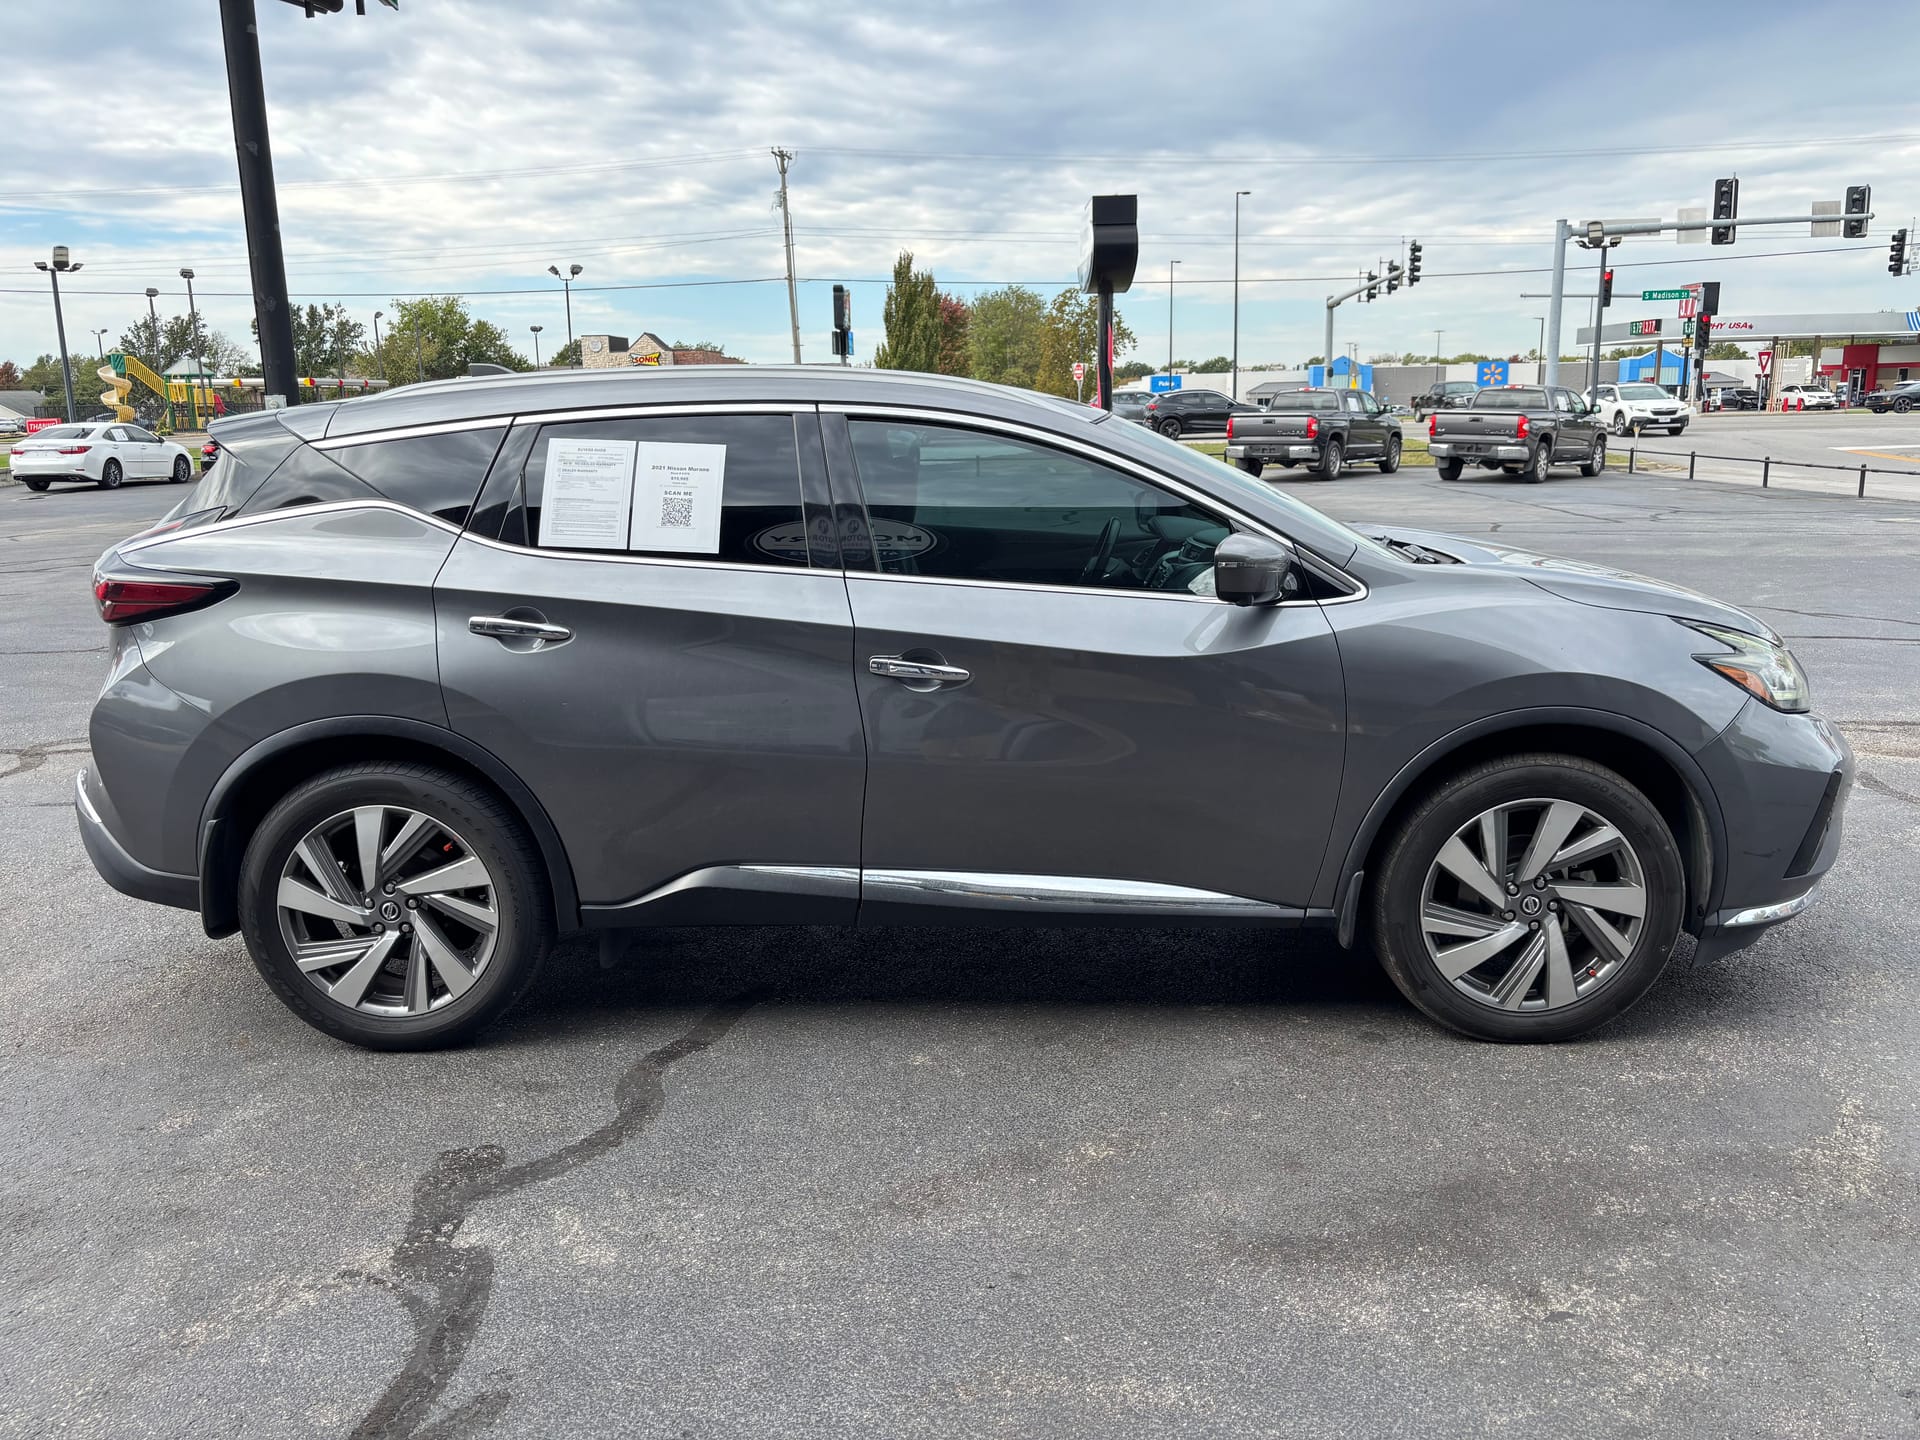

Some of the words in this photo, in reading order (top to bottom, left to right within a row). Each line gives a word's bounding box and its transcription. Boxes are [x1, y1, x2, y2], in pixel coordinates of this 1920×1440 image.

[1644, 292, 1649, 300] S
[1652, 291, 1679, 299] Madison
[1728, 322, 1748, 330] USA
